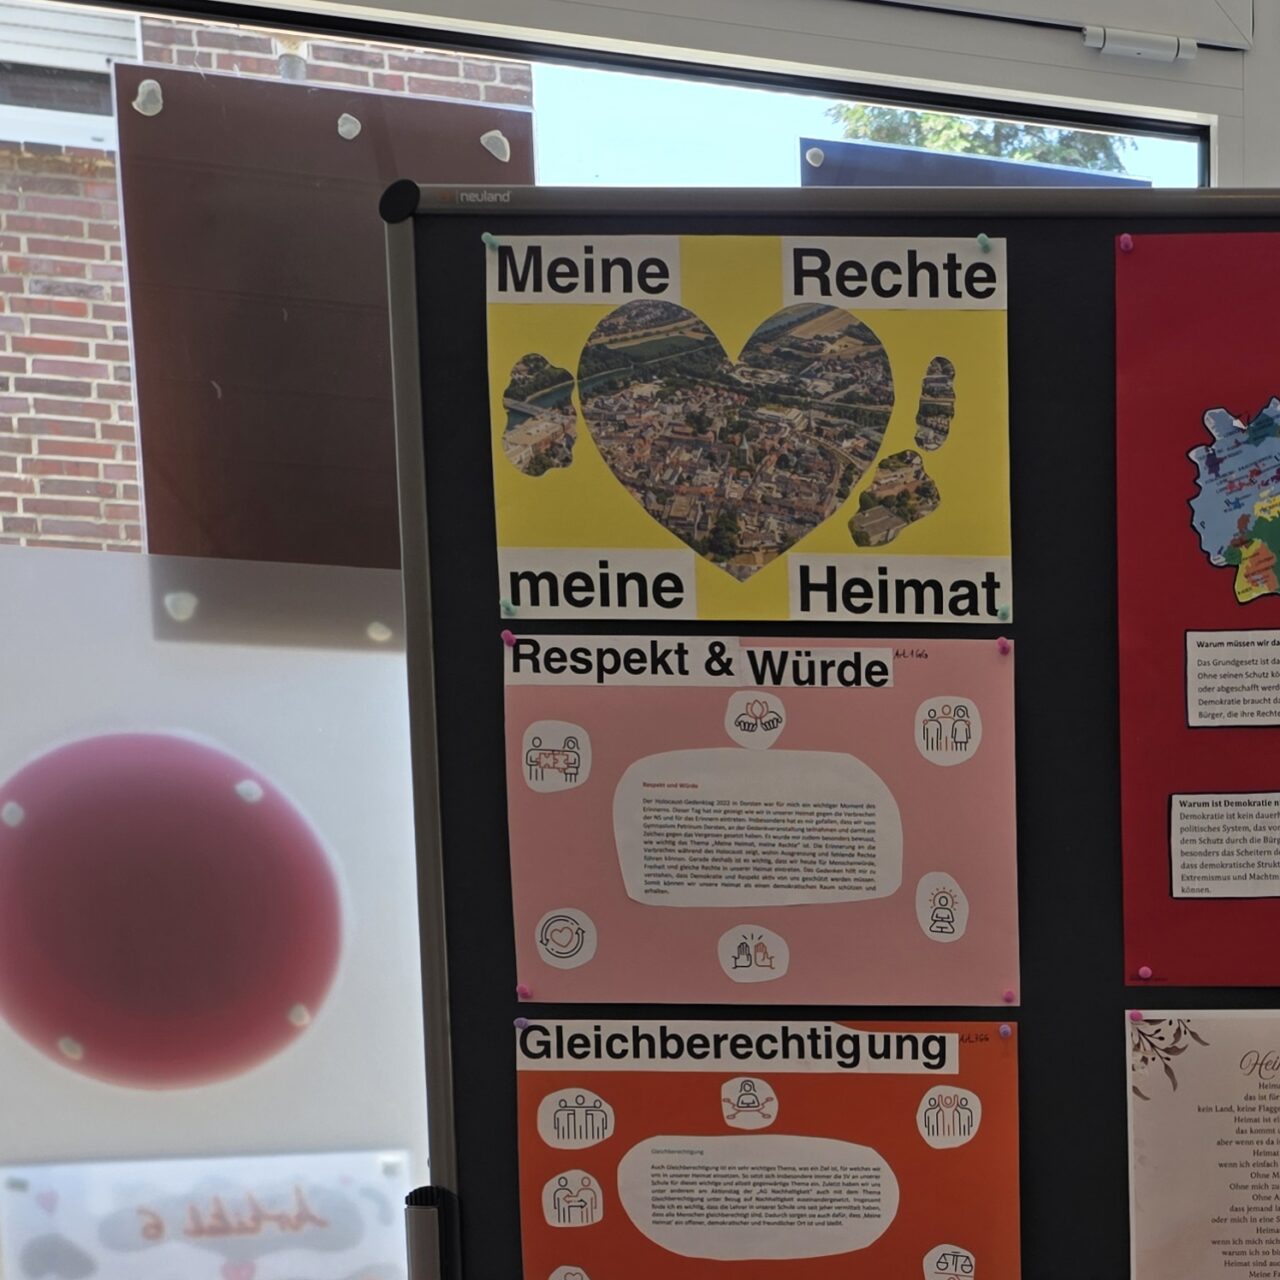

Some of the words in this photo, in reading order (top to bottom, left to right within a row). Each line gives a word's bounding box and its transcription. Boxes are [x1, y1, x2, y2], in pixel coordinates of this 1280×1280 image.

[460, 191, 510, 203] neuland
[497, 245, 670, 294] Meine
[792, 248, 997, 298] Rechte
[509, 560, 685, 609] meine
[800, 565, 1001, 616] Heimat
[512, 639, 689, 684] Respekt
[705, 641, 735, 677] &
[747, 650, 890, 687] Würde
[1197, 640, 1225, 648] Warum
[1227, 639, 1255, 647] müssen
[1180, 800, 1209, 808] Warum
[1224, 799, 1272, 807] Demokratie
[519, 1024, 946, 1068] Gleichberechtigung
